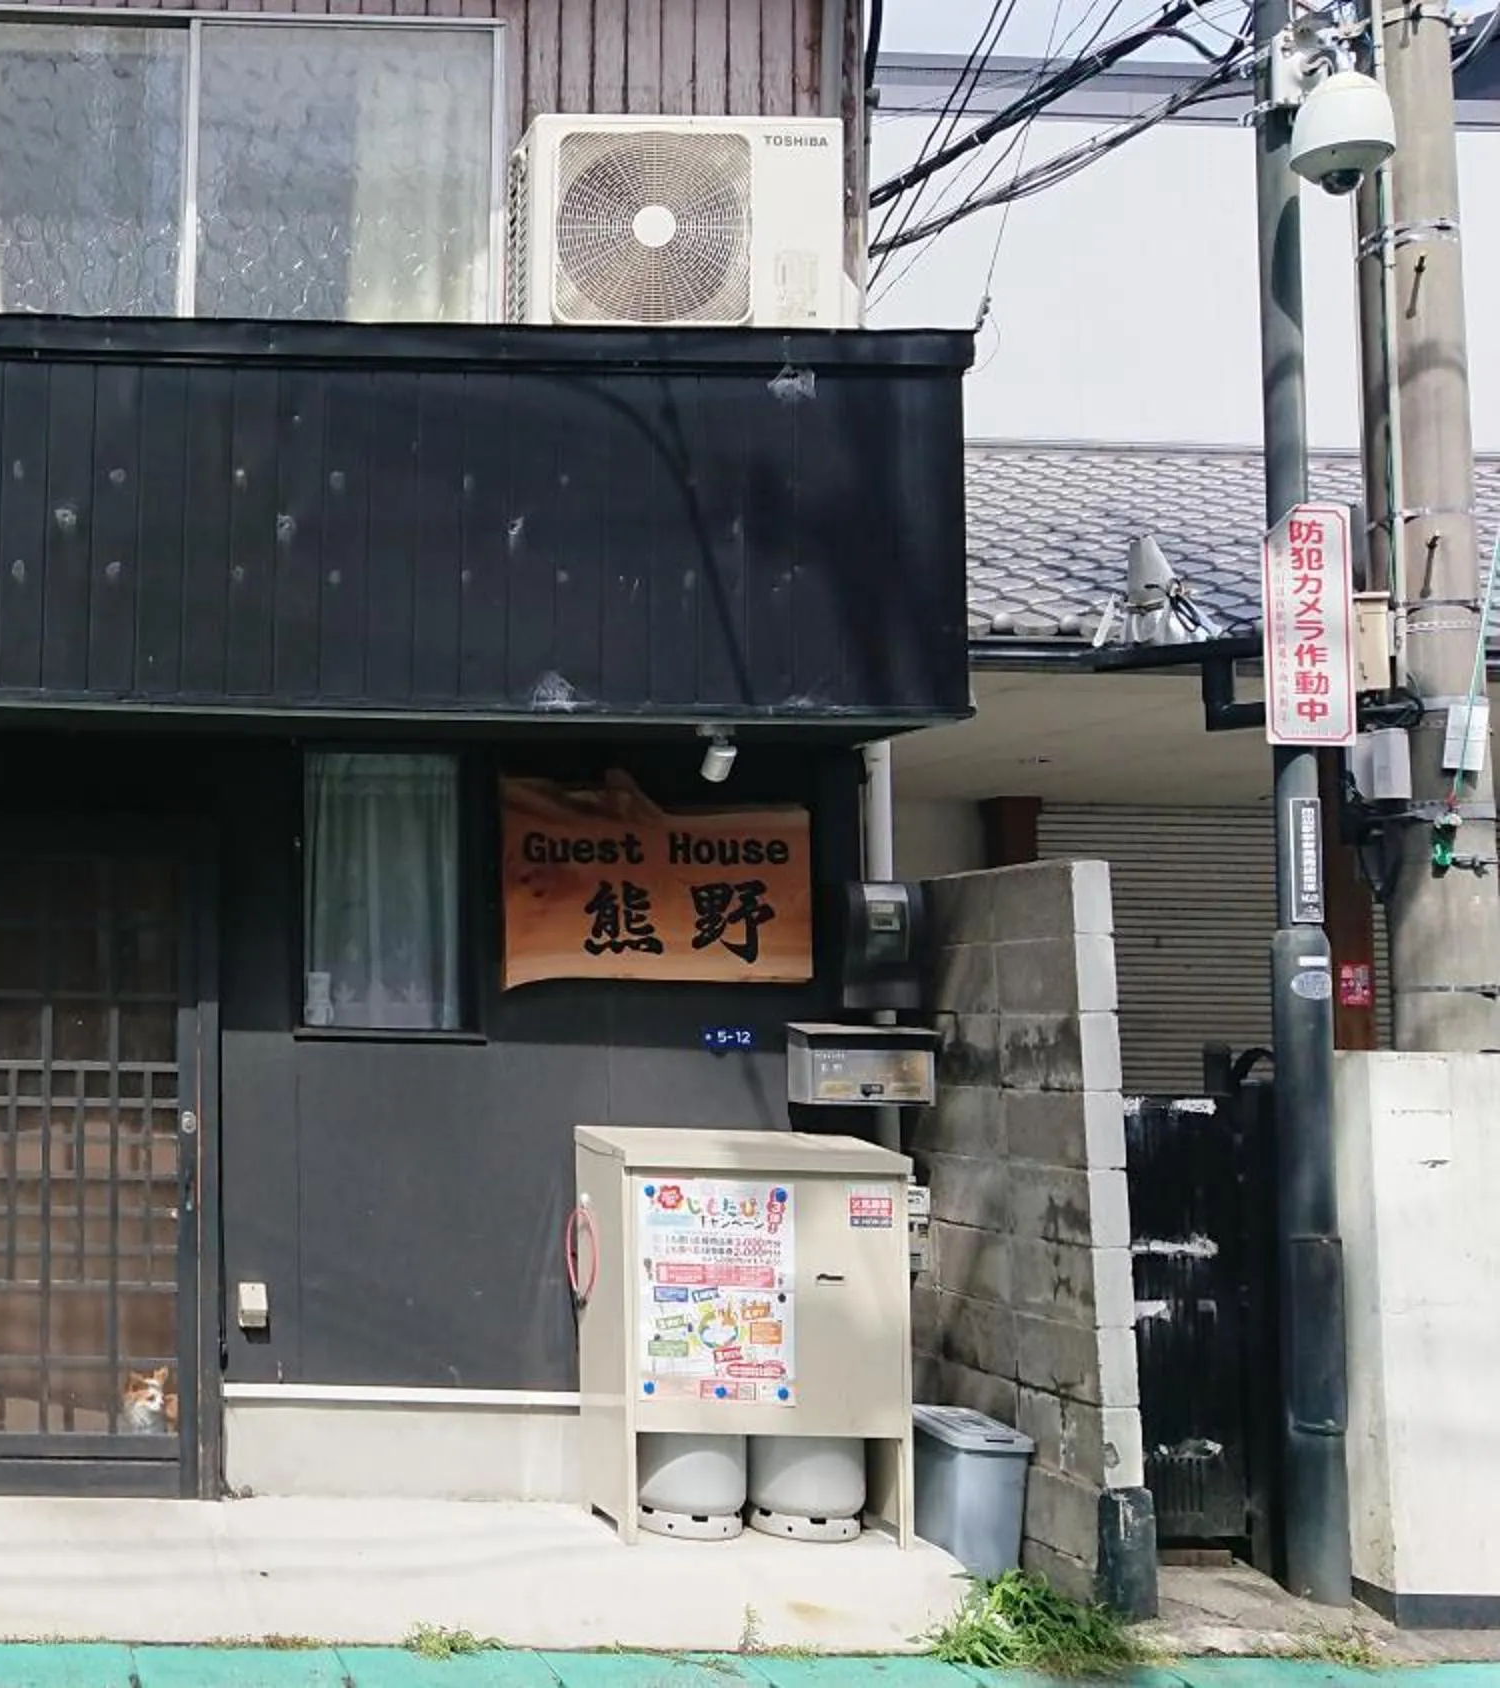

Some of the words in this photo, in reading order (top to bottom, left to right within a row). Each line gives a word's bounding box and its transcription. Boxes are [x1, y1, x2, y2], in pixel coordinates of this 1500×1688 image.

[763, 135, 828, 147] TOSHIBA
[1288, 519, 1331, 723] 防犯カメラ作動中
[522, 832, 645, 865] Guest
[668, 832, 790, 865] House
[583, 879, 776, 964] 熊野
[717, 1031, 751, 1044] 5-12
